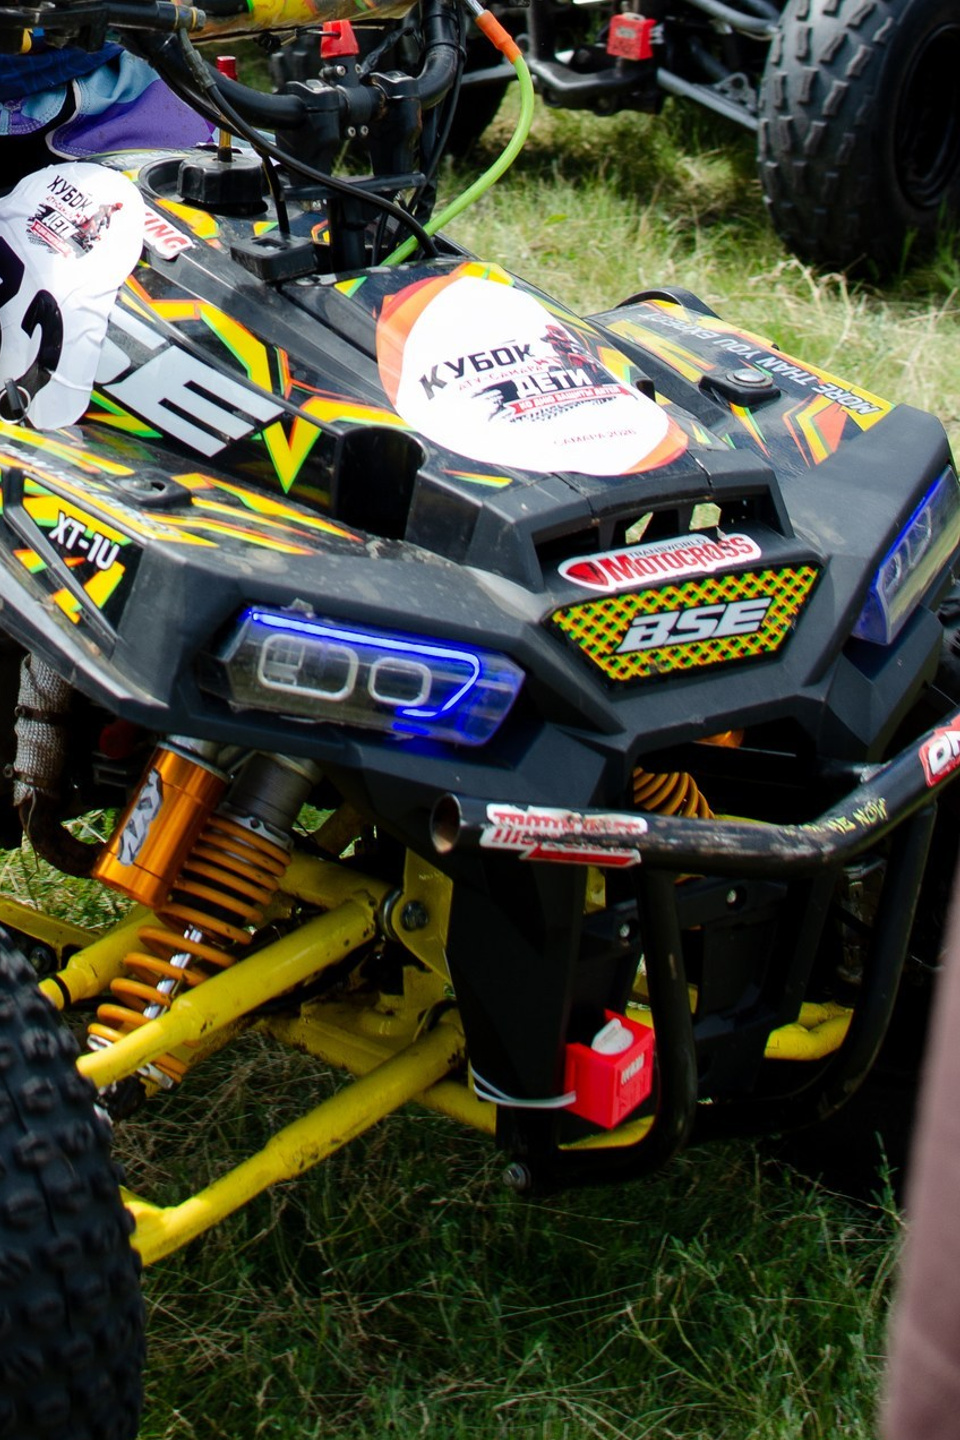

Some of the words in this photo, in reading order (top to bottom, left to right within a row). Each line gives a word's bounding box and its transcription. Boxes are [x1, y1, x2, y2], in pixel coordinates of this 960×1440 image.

[143, 211, 189, 250] ING
[637, 312, 721, 342] EXPECT
[713, 337, 762, 360] YOU
[418, 343, 536, 400] КУБОК
[515, 368, 594, 399] ДЕТИ
[755, 355, 821, 386] THAN
[812, 381, 883, 417] MORE
[600, 536, 755, 583] MOTOCROSS
[628, 536, 709, 559] TRANSWORLD
[615, 596, 774, 654] BSE
